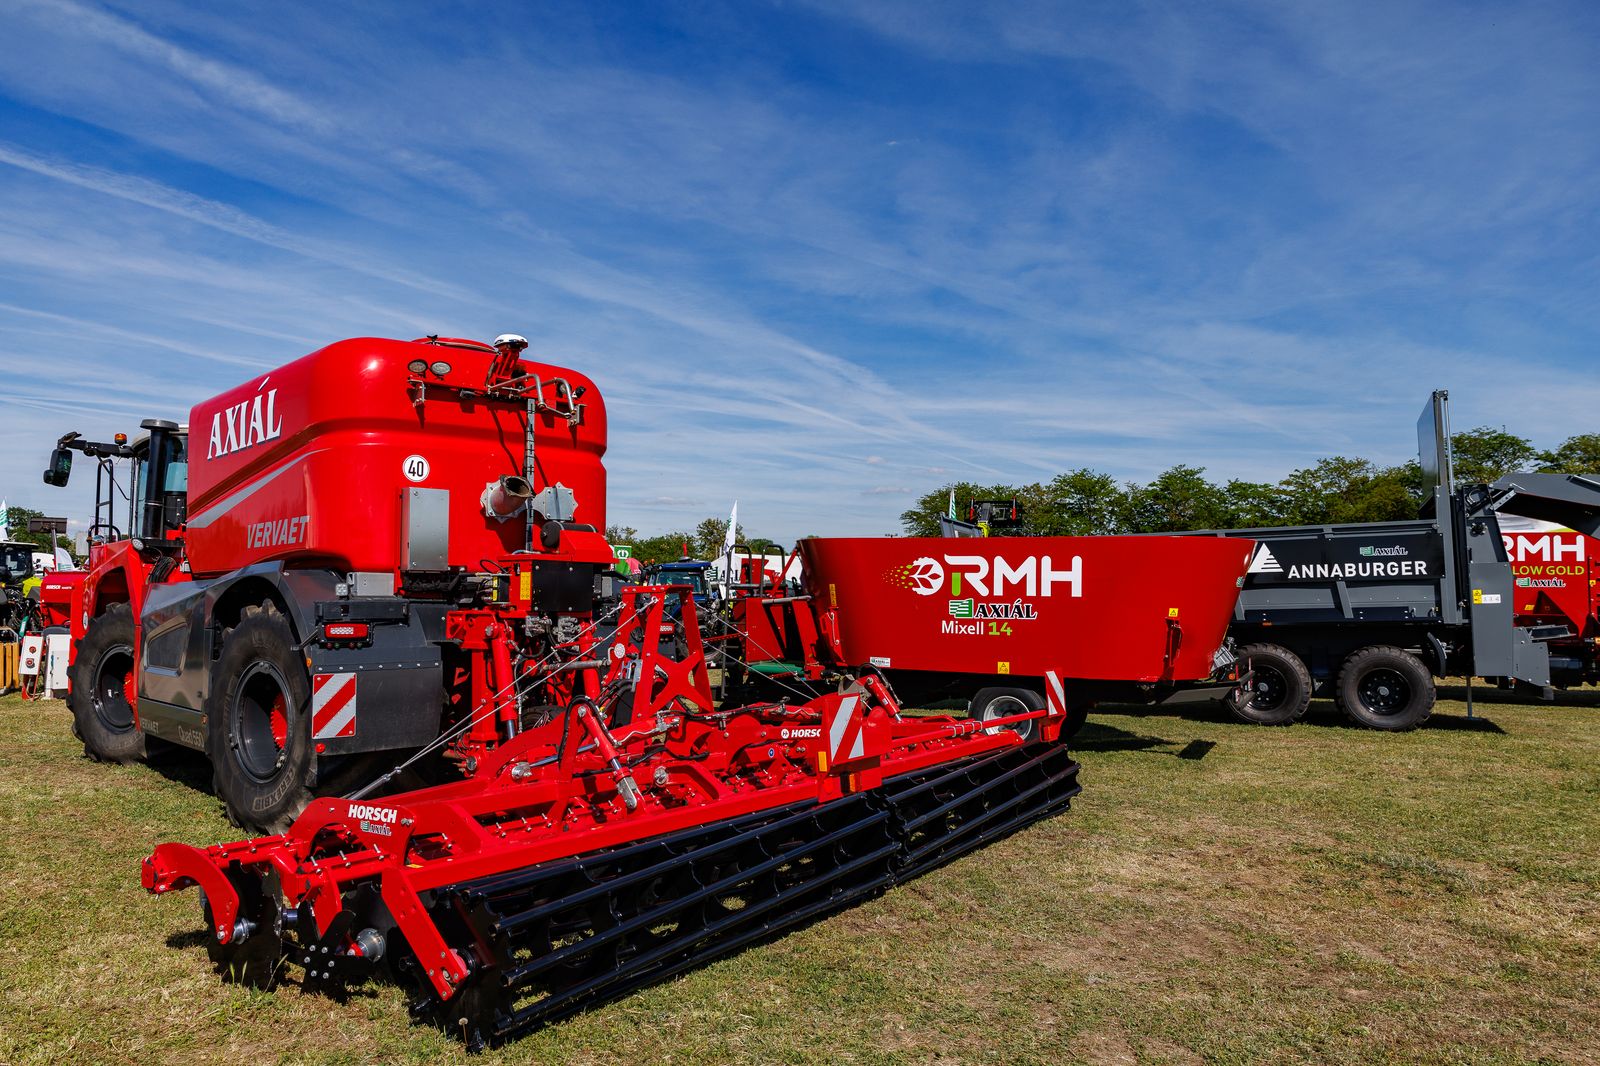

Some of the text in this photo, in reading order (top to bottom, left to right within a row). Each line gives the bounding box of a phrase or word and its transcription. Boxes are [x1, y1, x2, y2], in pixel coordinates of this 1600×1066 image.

[207, 376, 282, 461] AXIÁL
[408, 459, 424, 477] 40
[247, 515, 310, 549] VERVAET
[1373, 545, 1408, 556] AXIÁL
[943, 553, 1083, 598] RMH
[1288, 560, 1428, 579] ANNABURGER
[1546, 565, 1585, 576] GOLD
[1531, 576, 1566, 588] AXIÁL
[974, 598, 1038, 620] AXIÁL
[941, 620, 1013, 636] Mixell 14
[347, 804, 398, 824] HORSCH
